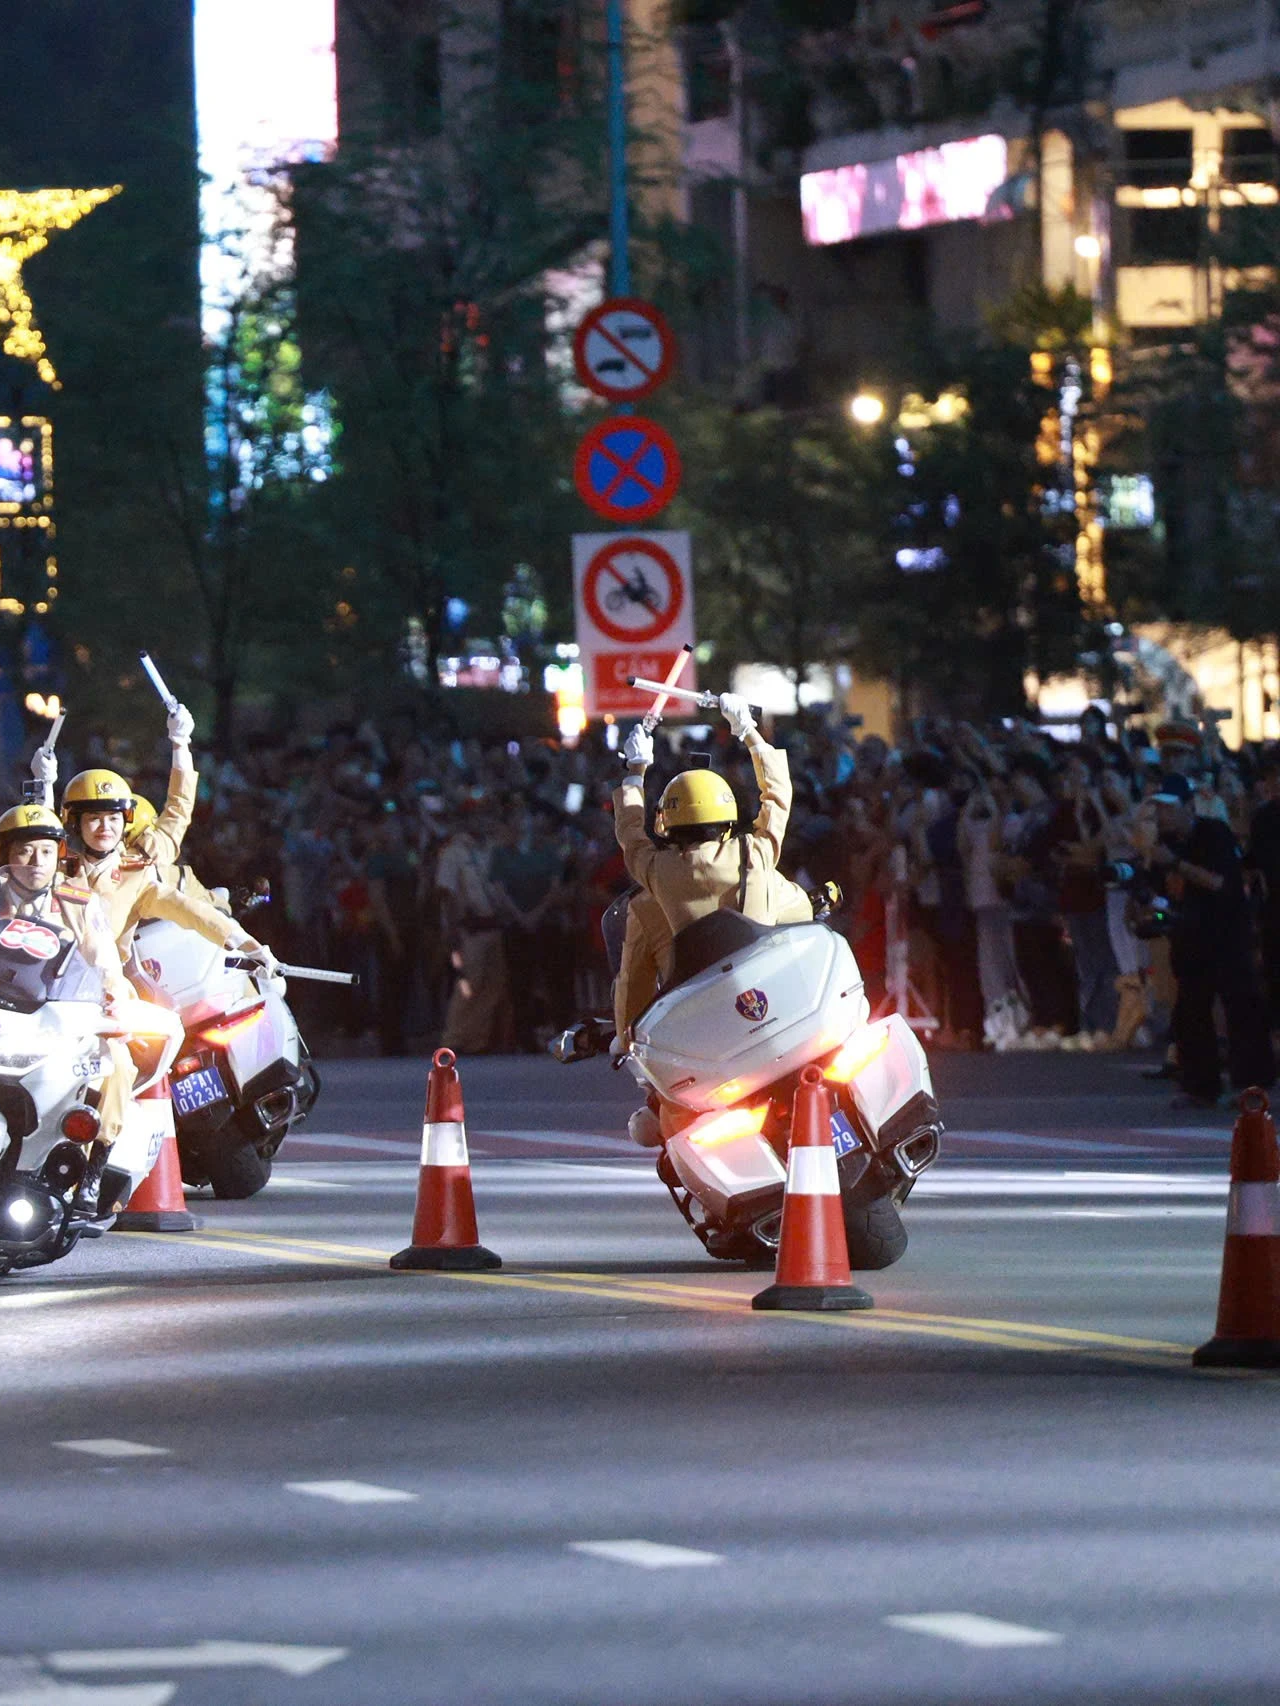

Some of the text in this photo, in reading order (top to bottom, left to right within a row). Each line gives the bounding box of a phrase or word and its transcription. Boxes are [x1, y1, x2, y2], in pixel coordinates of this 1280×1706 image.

[72, 1060, 101, 1077] CSGT
[175, 1070, 213, 1096] 59-A1
[179, 1083, 223, 1112] 012.34
